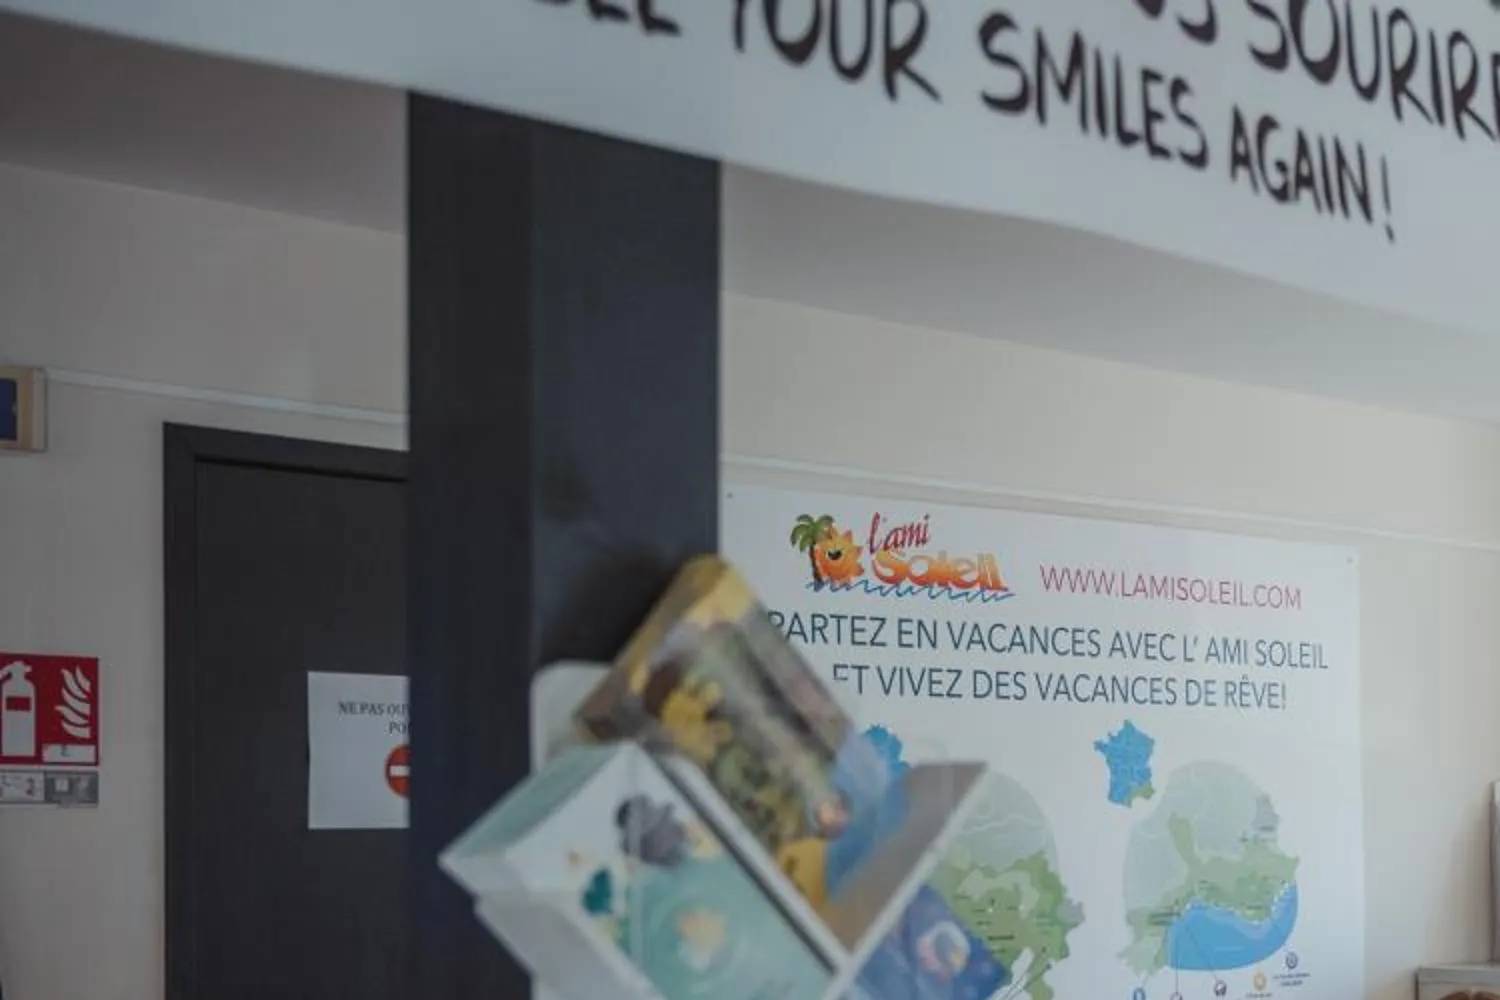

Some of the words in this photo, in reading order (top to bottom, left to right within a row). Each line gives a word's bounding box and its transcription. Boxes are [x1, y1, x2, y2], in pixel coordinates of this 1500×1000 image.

[977, 13, 1210, 172] SMILES
[1230, 103, 1396, 243] AGAIN!
[1039, 562, 1302, 612] WWW.LAMISOLEIL.COM
[767, 609, 888, 648] PARTEZ
[897, 617, 938, 650] EN
[946, 619, 1101, 660] VACANCES
[1108, 631, 1177, 663] AVEC
[1254, 639, 1330, 671] SOLEIL
[360, 702, 385, 716] PAS
[876, 664, 964, 699] VIVEZ
[972, 668, 1028, 703] DES
[1035, 671, 1178, 706] VACANCES
[1184, 679, 1217, 707] DE
[1224, 674, 1287, 711] RÊVE!
